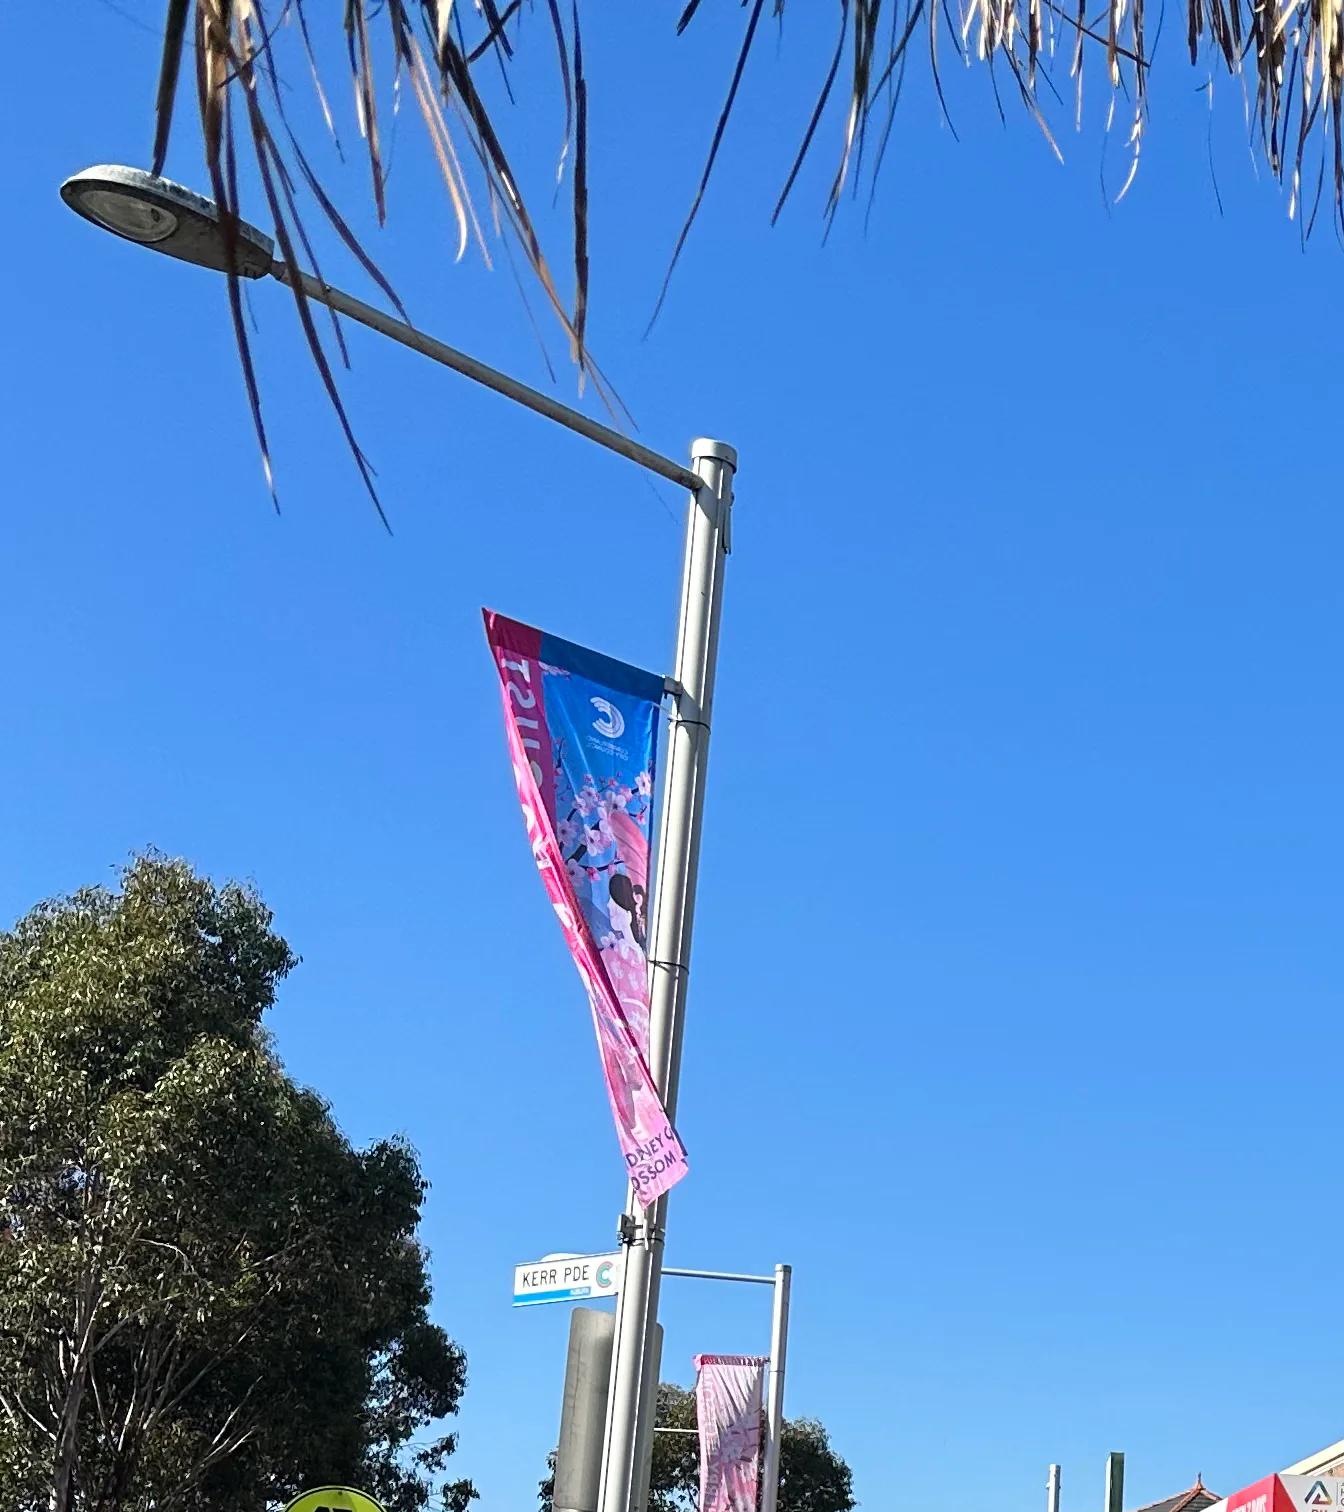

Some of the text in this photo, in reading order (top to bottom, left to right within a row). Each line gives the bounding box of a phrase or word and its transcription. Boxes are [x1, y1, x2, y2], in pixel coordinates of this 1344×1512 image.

[630, 1150, 676, 1190] OSSOM
[522, 1268, 557, 1288] KERR
[564, 1264, 590, 1283] PDE
